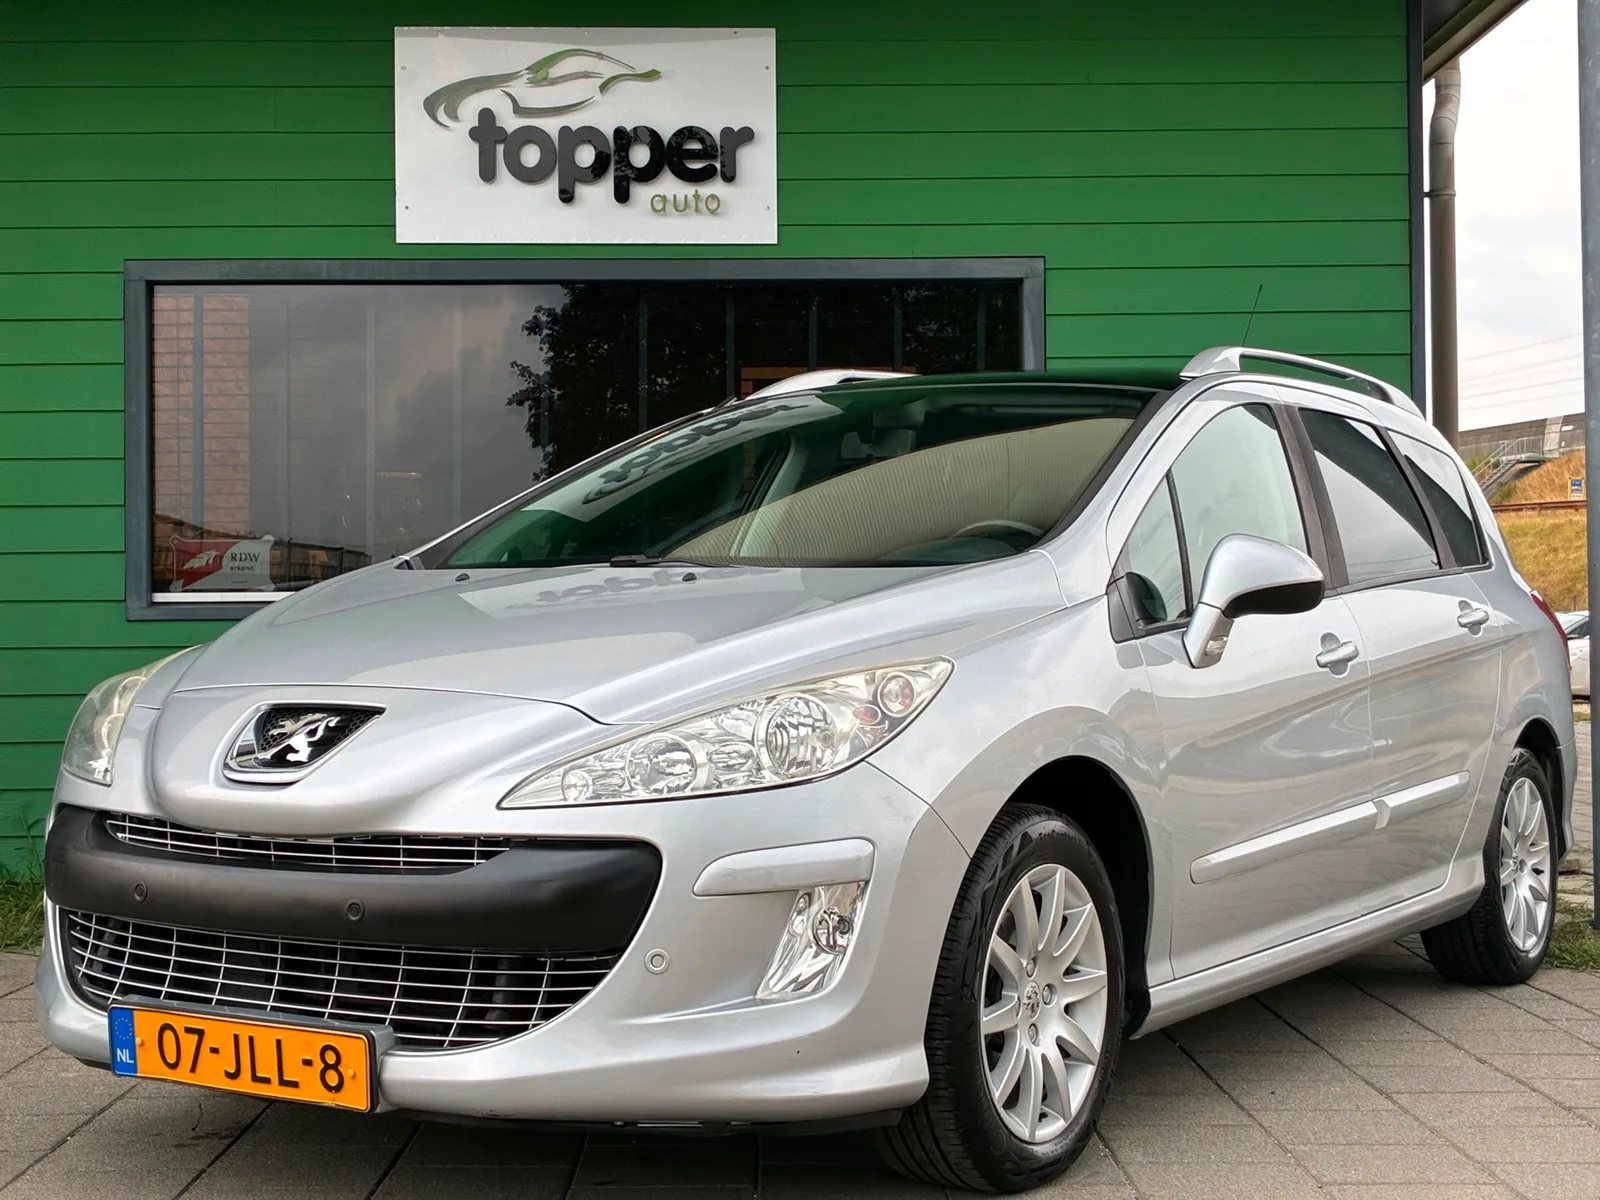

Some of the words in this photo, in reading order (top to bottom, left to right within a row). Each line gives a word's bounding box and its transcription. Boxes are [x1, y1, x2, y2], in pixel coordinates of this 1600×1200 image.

[468, 107, 755, 204] topper
[650, 189, 721, 215] auto
[230, 552, 260, 562] RDW
[116, 1046, 134, 1064] NL
[157, 1022, 345, 1093] 07-JLL-8
